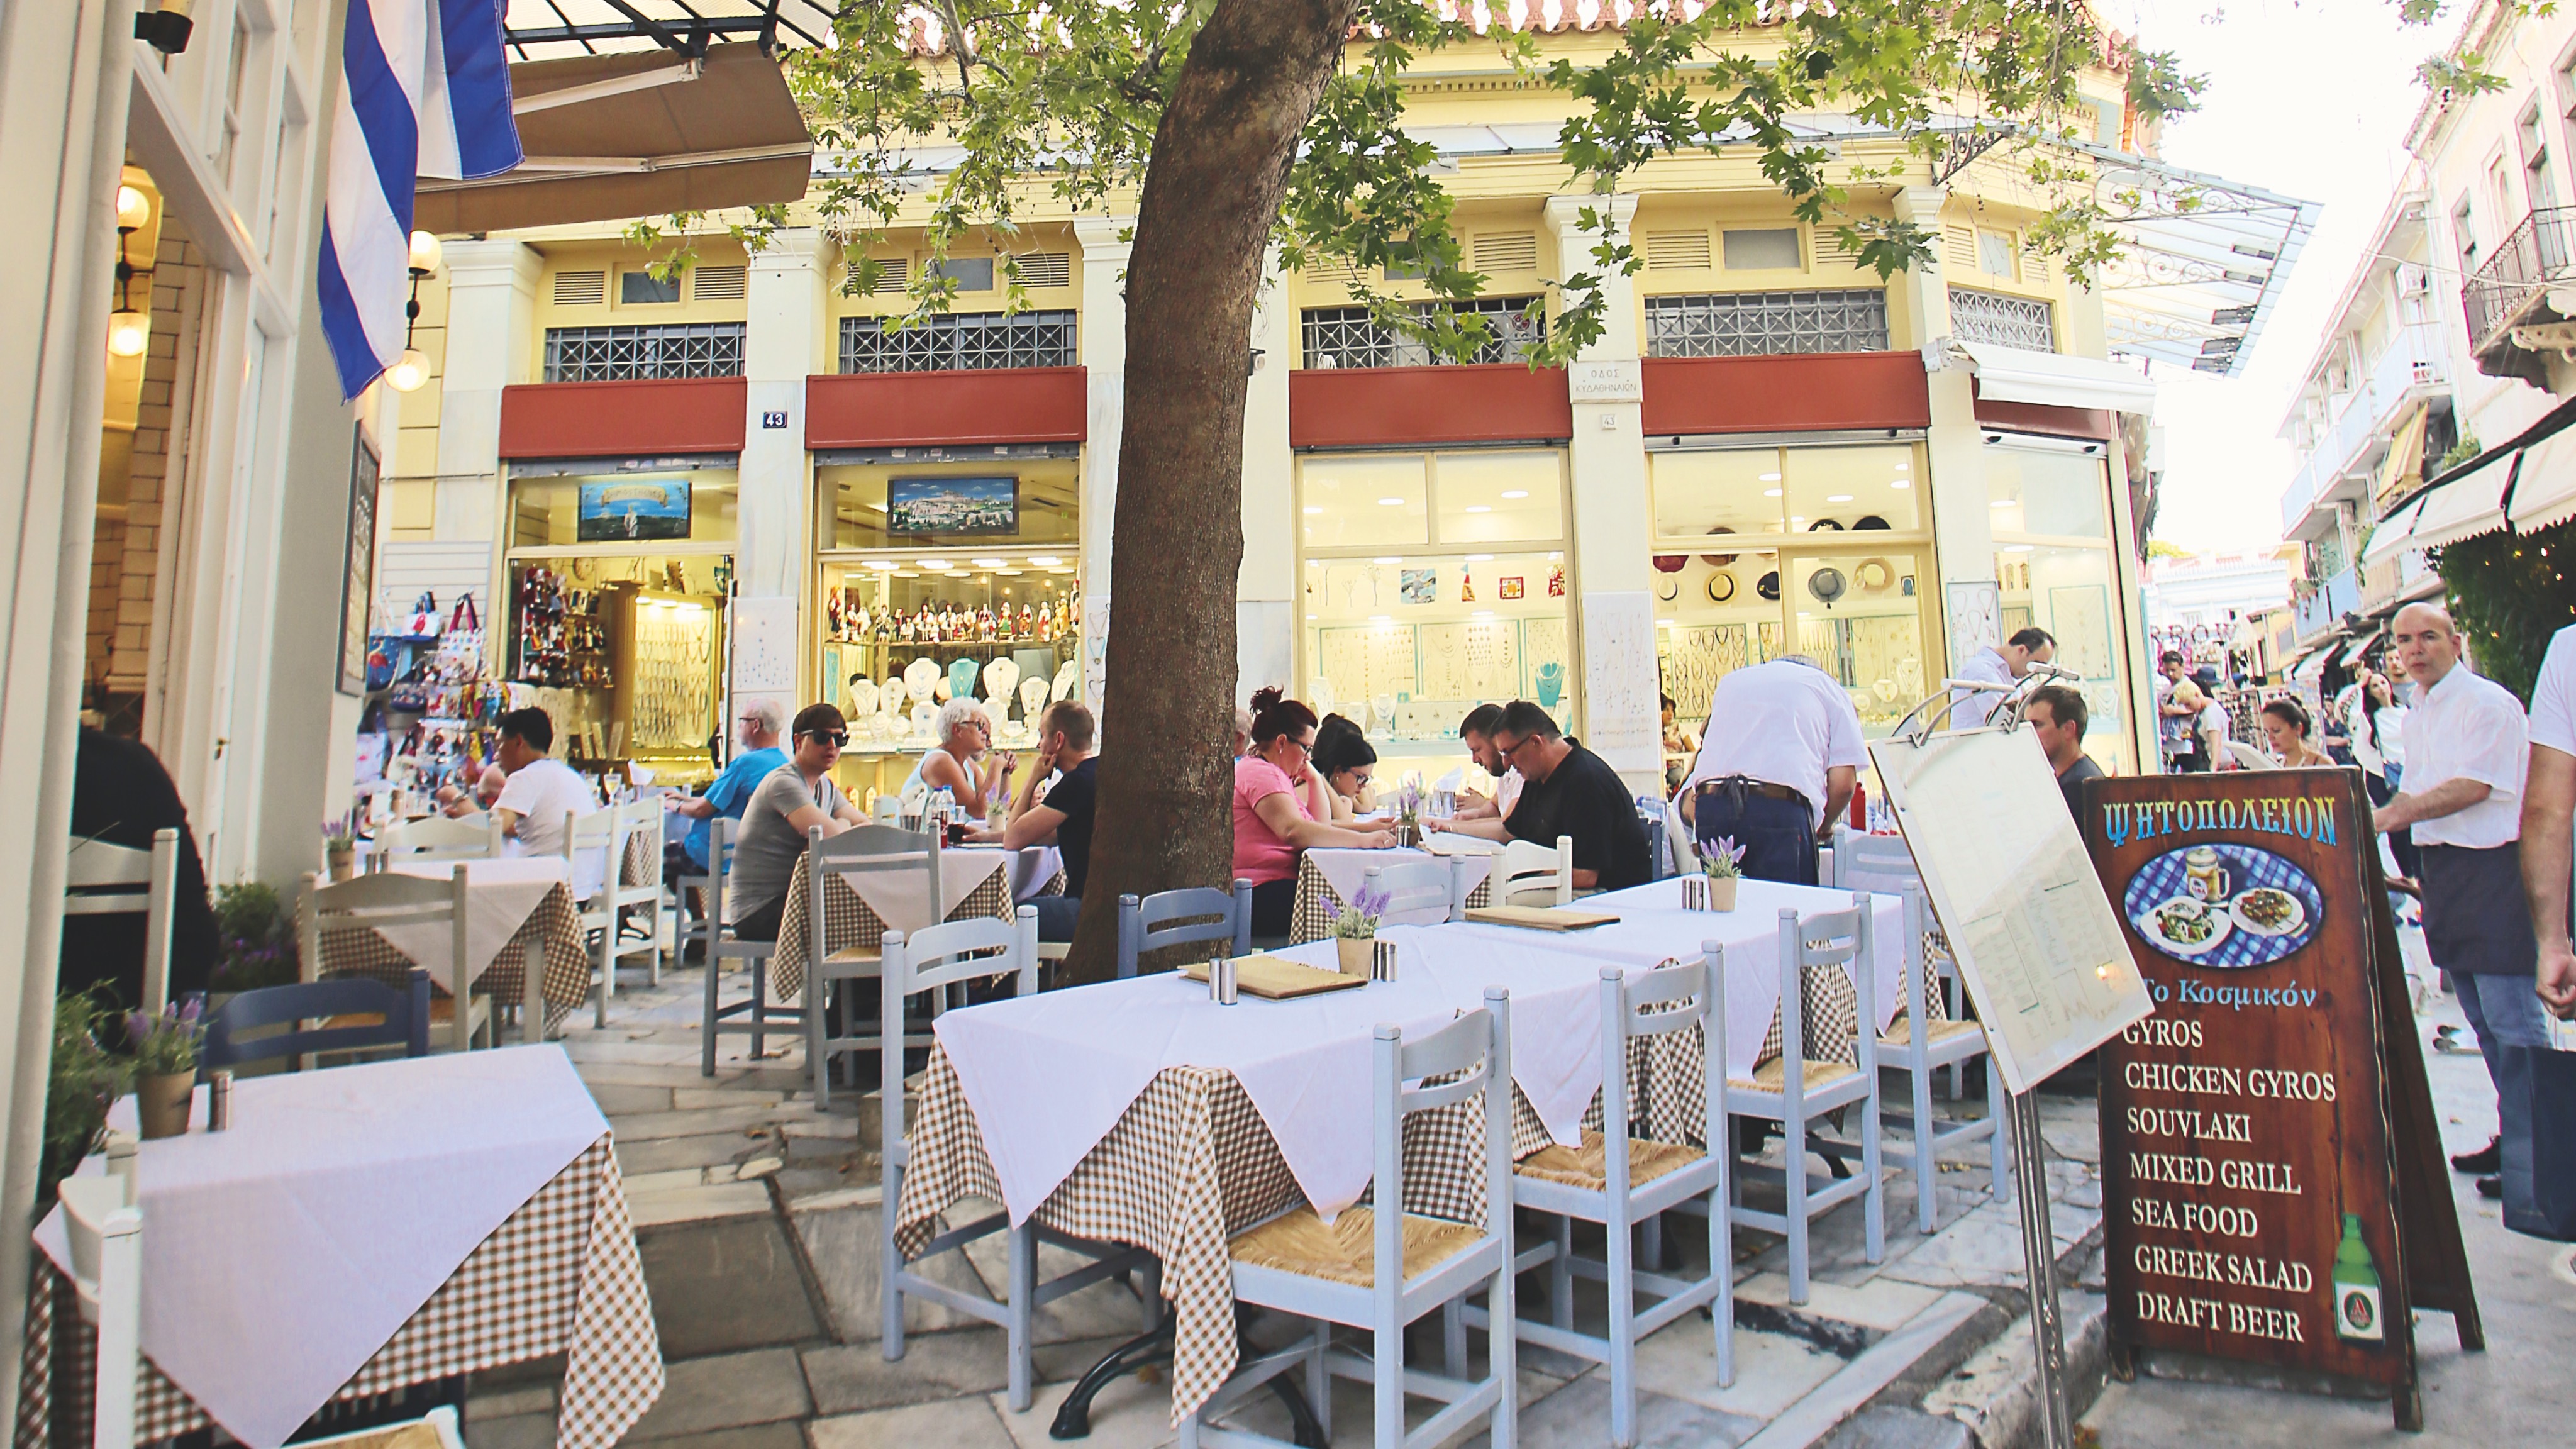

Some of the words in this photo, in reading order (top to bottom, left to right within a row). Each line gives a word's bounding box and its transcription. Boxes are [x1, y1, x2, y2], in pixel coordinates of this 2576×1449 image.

[1591, 369, 1619, 378] ΟΔΟΣ
[766, 413, 784, 426] 43
[1604, 416, 1614, 426] 43
[2103, 796, 2338, 847] ΨΗΤΟΠΩΛΕΙΟΝ
[2178, 979, 2318, 1011] Κοσμικόν
[2123, 1019, 2203, 1047] GYROS
[2124, 1062, 2241, 1096] CHICKEN
[2247, 1068, 2336, 1102] GYROS
[2127, 1107, 2252, 1143] SOUVLAKI
[2129, 1152, 2214, 1186] MIXED
[2220, 1160, 2301, 1194] GRILL
[2132, 1199, 2177, 1230] SEA
[2183, 1204, 2258, 1238] FOOD
[2134, 1245, 2223, 1282] GREEK
[2228, 1253, 2312, 1293] SALAD
[2137, 1291, 2222, 1331] DRAFT
[2229, 1304, 2304, 1343] BEER
